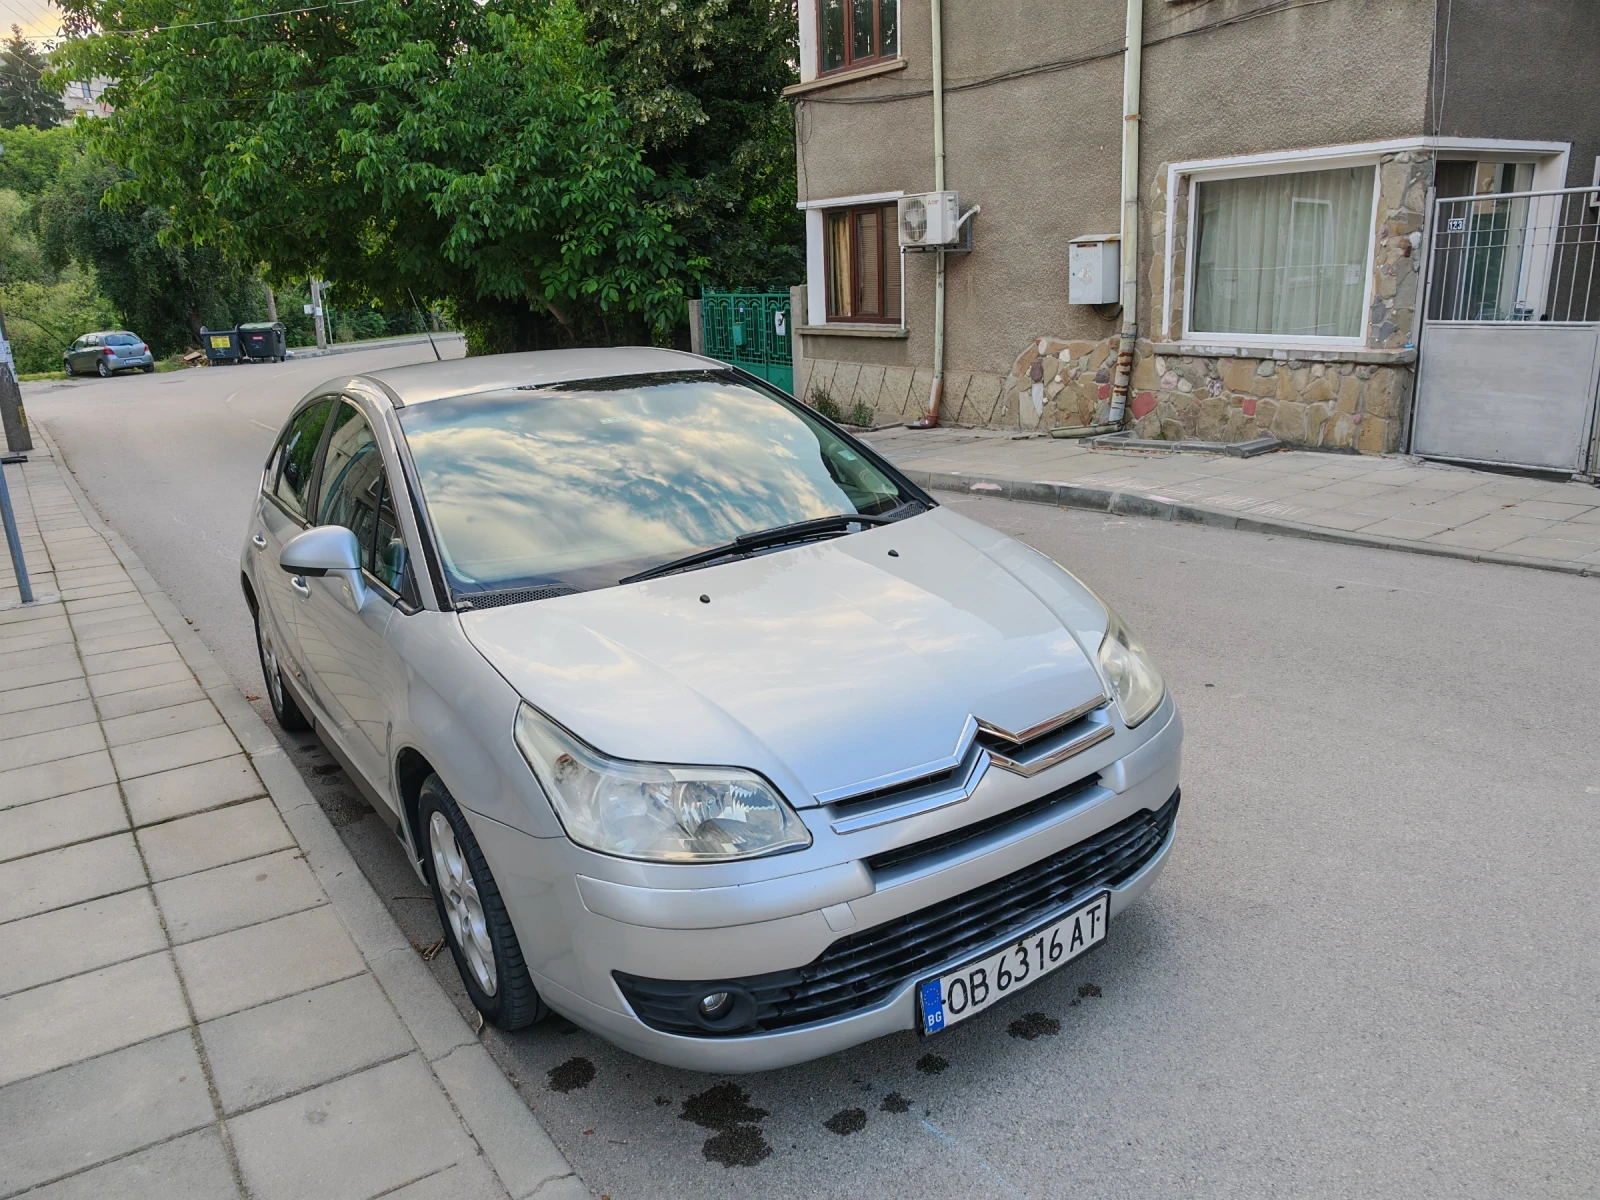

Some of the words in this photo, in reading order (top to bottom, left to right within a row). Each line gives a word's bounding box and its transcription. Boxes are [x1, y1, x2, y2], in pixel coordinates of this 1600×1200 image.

[1449, 220, 1463, 230] 123
[948, 967, 989, 1014] OB
[997, 928, 1064, 991] 6316
[1069, 904, 1101, 952] AT
[927, 1010, 942, 1027] BG
